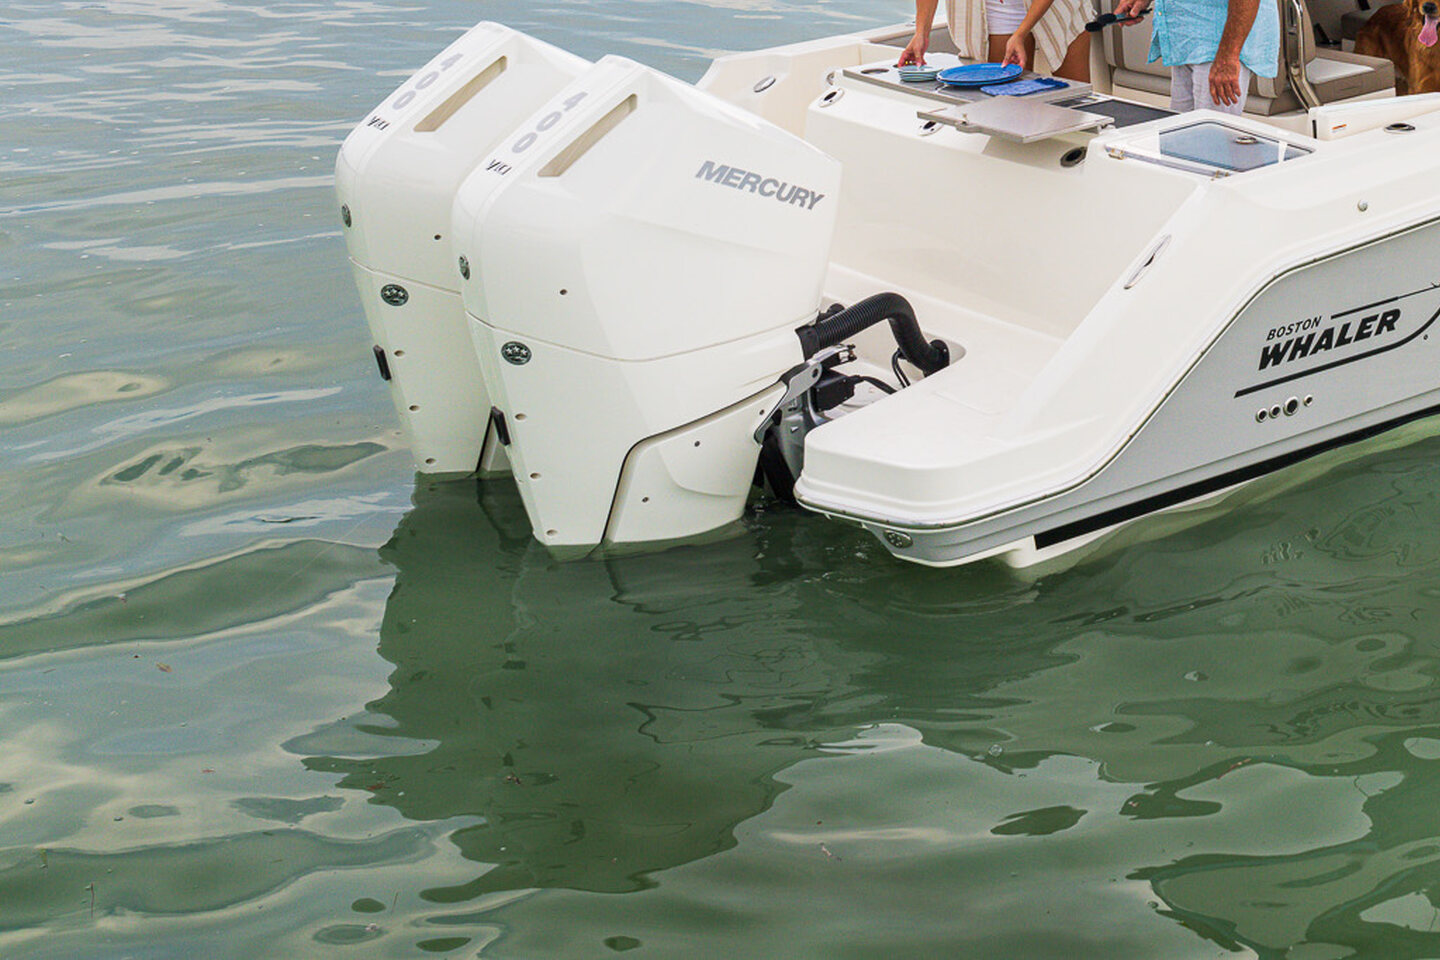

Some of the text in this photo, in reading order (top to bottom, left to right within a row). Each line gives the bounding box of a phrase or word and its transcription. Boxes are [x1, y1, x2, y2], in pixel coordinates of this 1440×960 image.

[695, 160, 825, 210] MERCURY
[1258, 308, 1401, 371] WHALER
[1266, 316, 1322, 341] BOSTON
